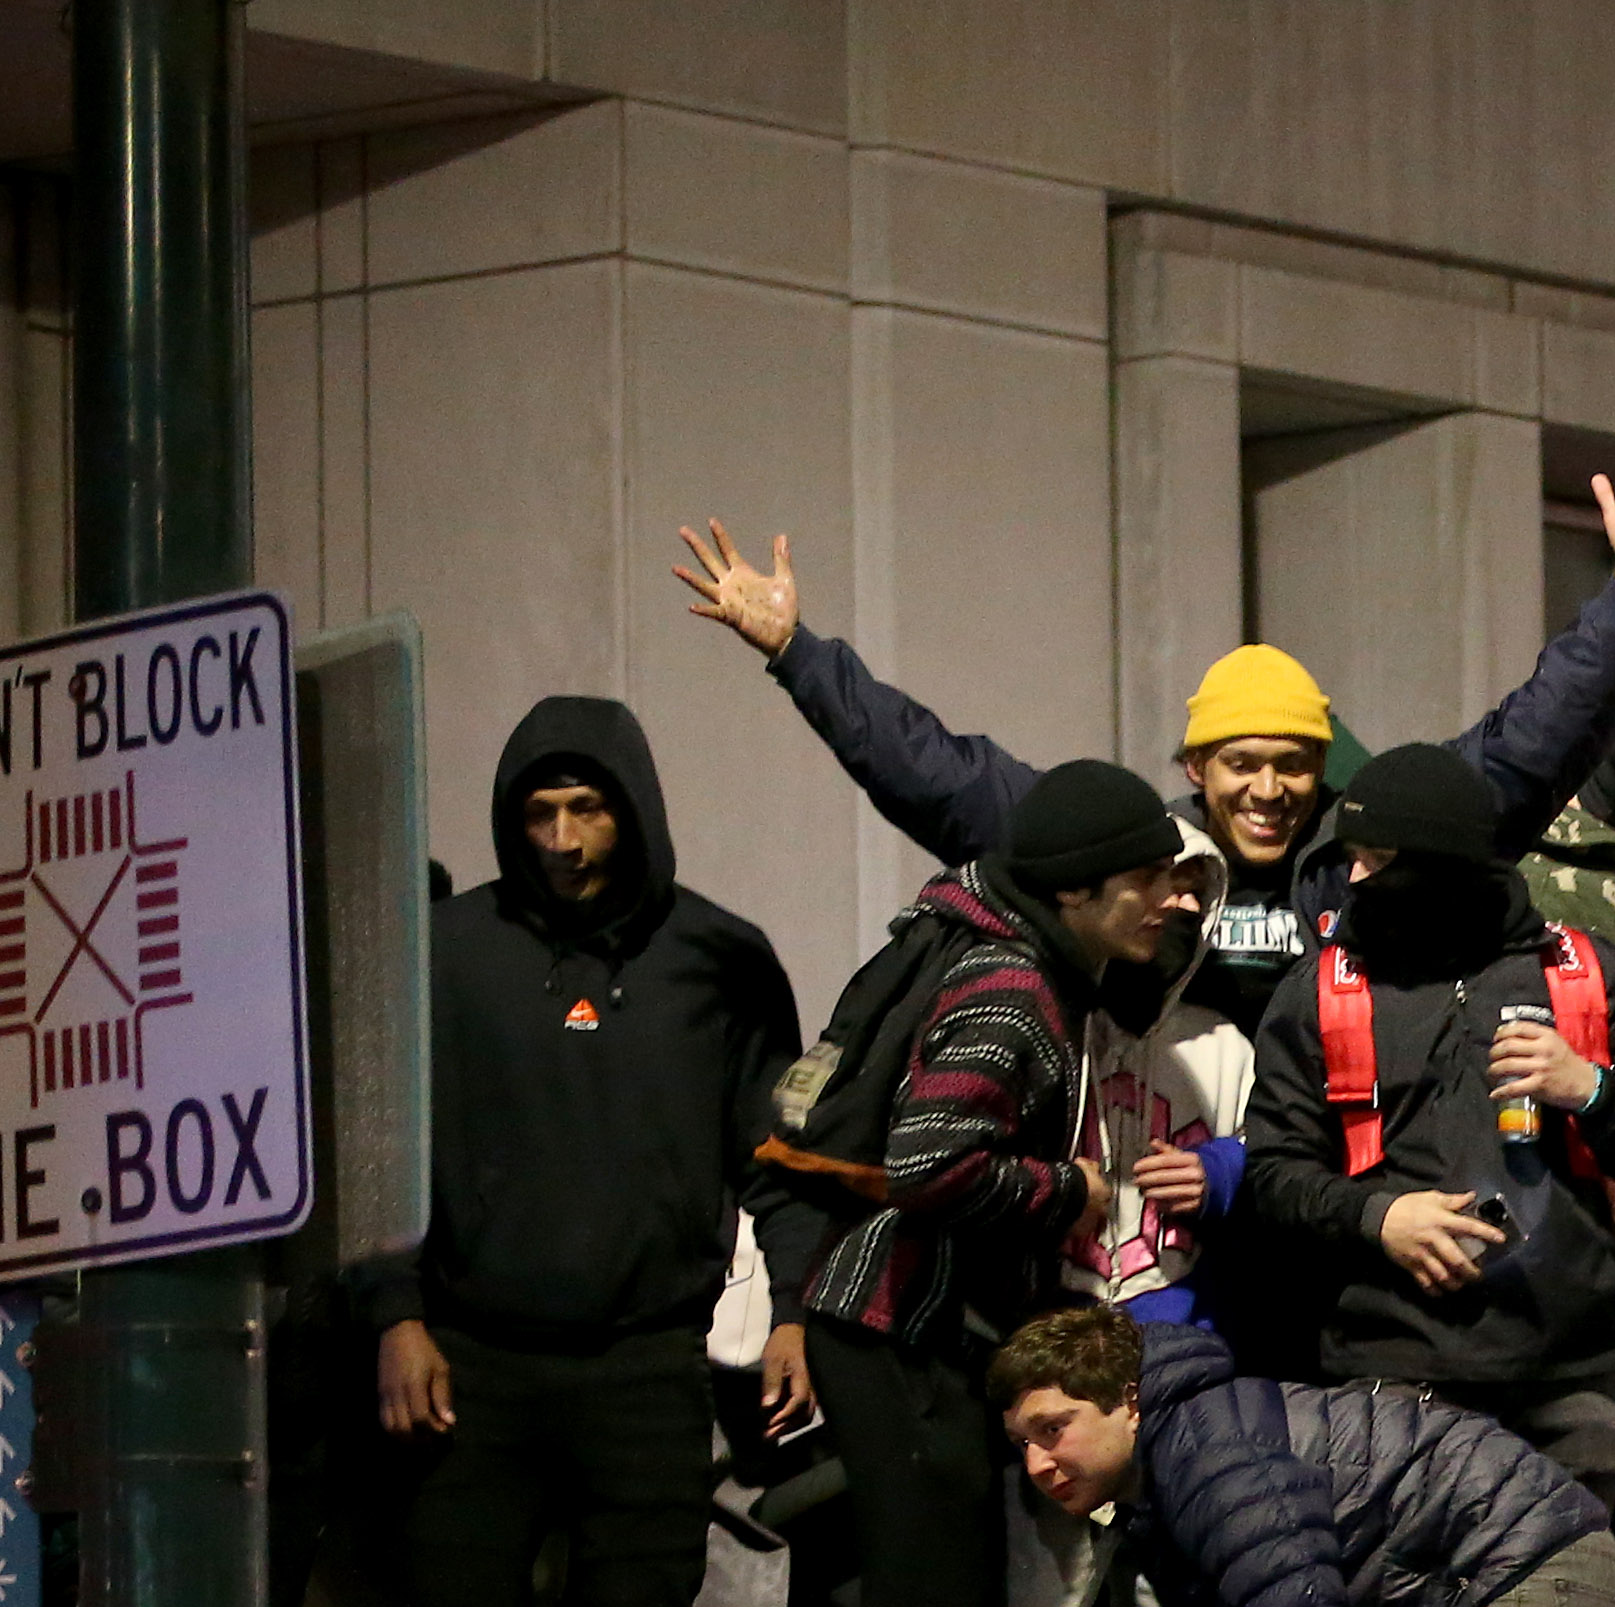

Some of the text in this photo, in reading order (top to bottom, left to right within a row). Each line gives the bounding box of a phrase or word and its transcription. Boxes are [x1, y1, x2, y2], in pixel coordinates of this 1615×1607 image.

[76, 626, 265, 760] BLOCK
[0, 1086, 272, 1244] E BOX
